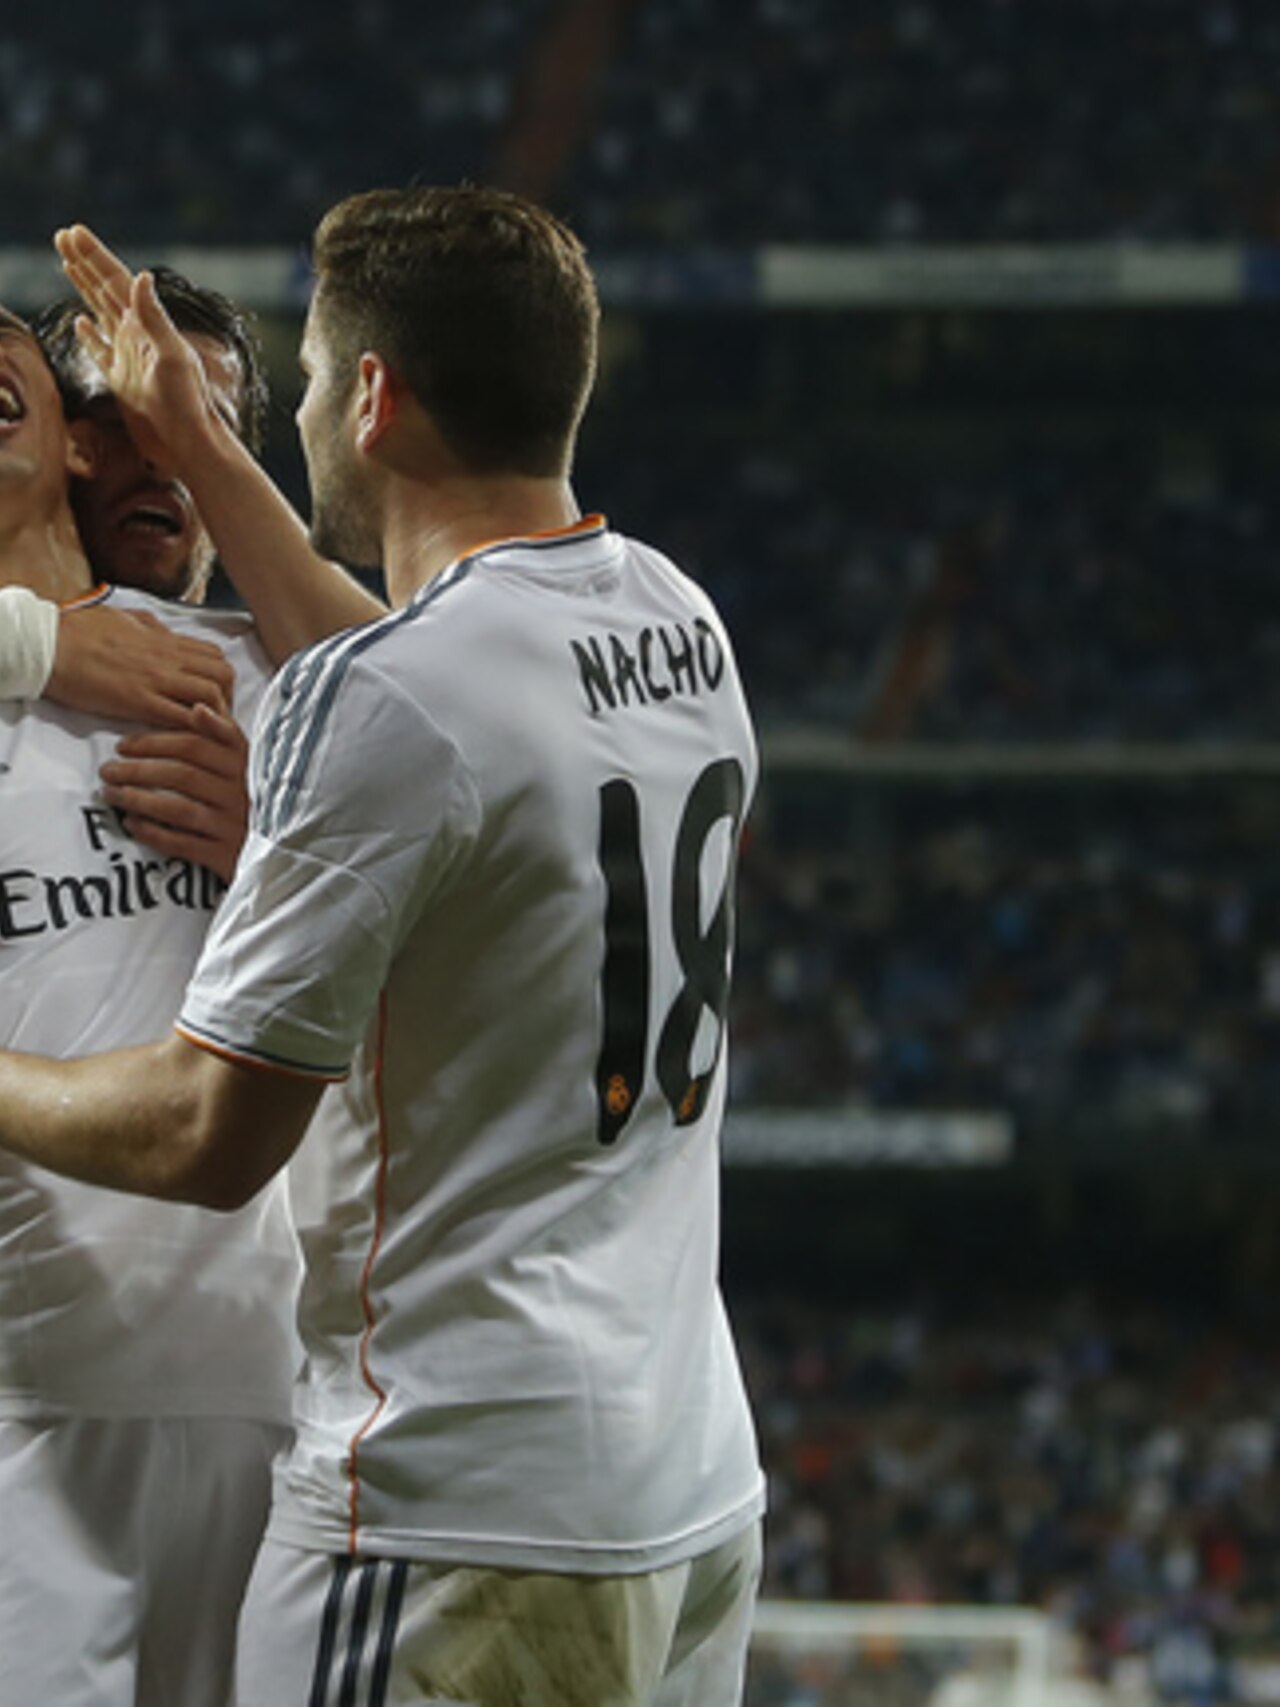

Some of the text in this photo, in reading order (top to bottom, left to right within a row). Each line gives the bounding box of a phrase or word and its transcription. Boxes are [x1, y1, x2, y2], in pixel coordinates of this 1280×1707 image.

[570, 616, 724, 713] NACHO
[81, 805, 135, 851] Fl
[596, 758, 744, 1146] 18
